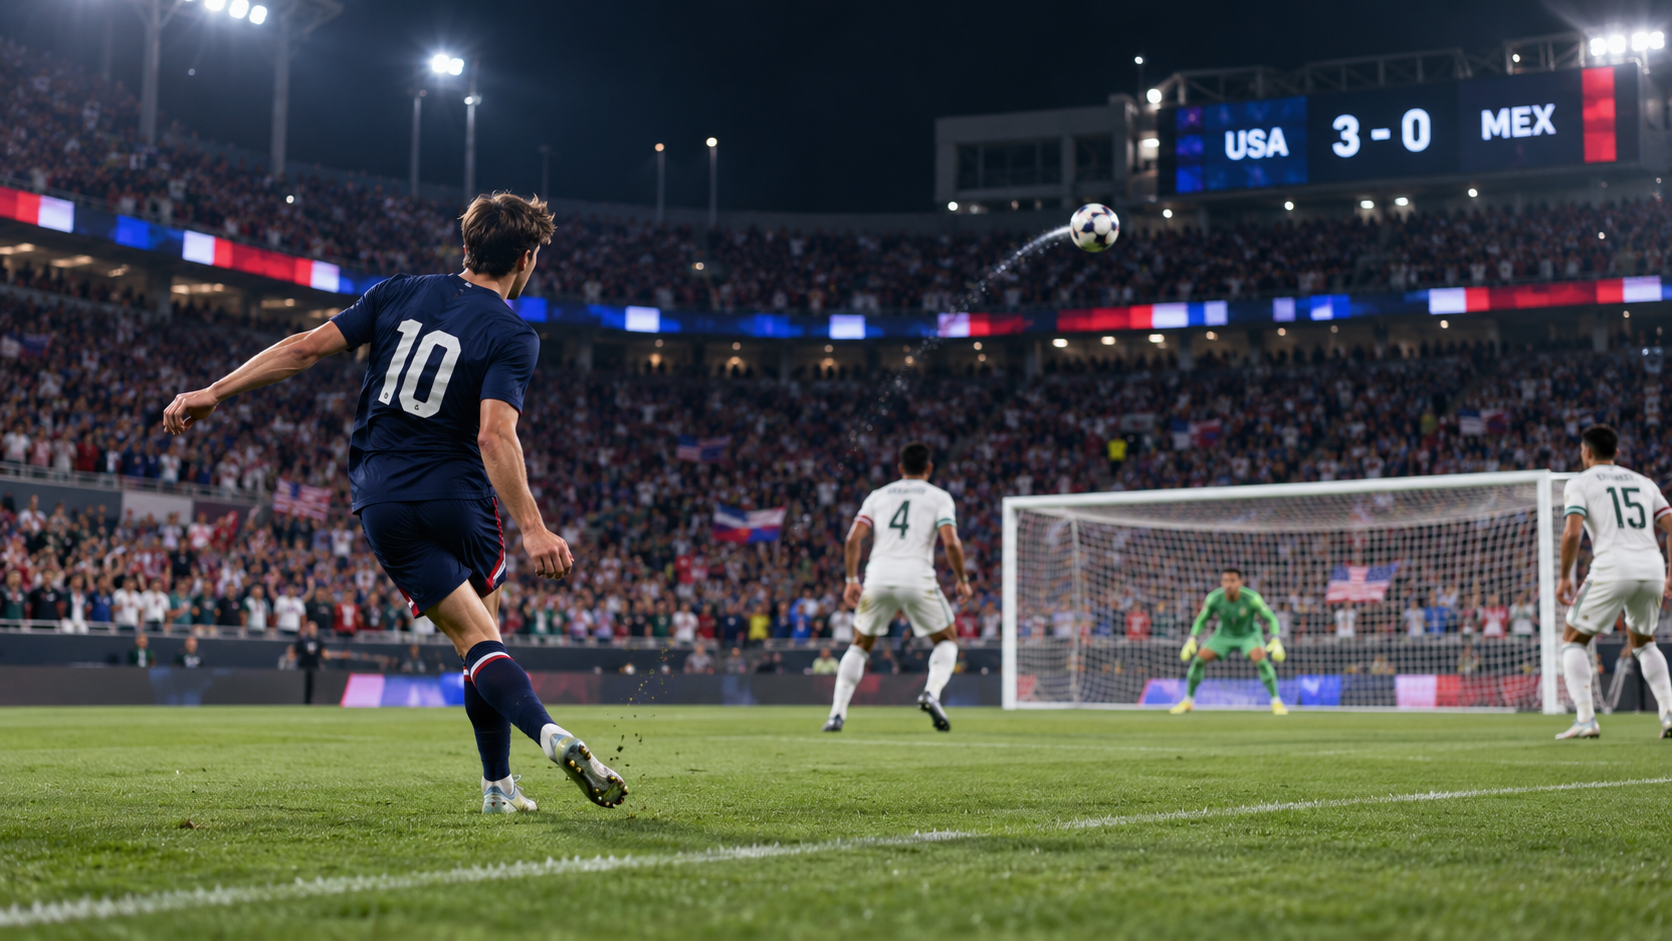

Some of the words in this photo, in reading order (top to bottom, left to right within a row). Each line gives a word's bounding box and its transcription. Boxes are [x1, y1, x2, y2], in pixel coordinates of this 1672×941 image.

[1225, 127, 1289, 160] USA
[1332, 114, 1360, 158] 3
[1401, 108, 1431, 152] 0
[1481, 103, 1557, 141] MEX
[378, 319, 462, 418] 10
[888, 500, 911, 539] 4
[1606, 486, 1647, 530] 15
